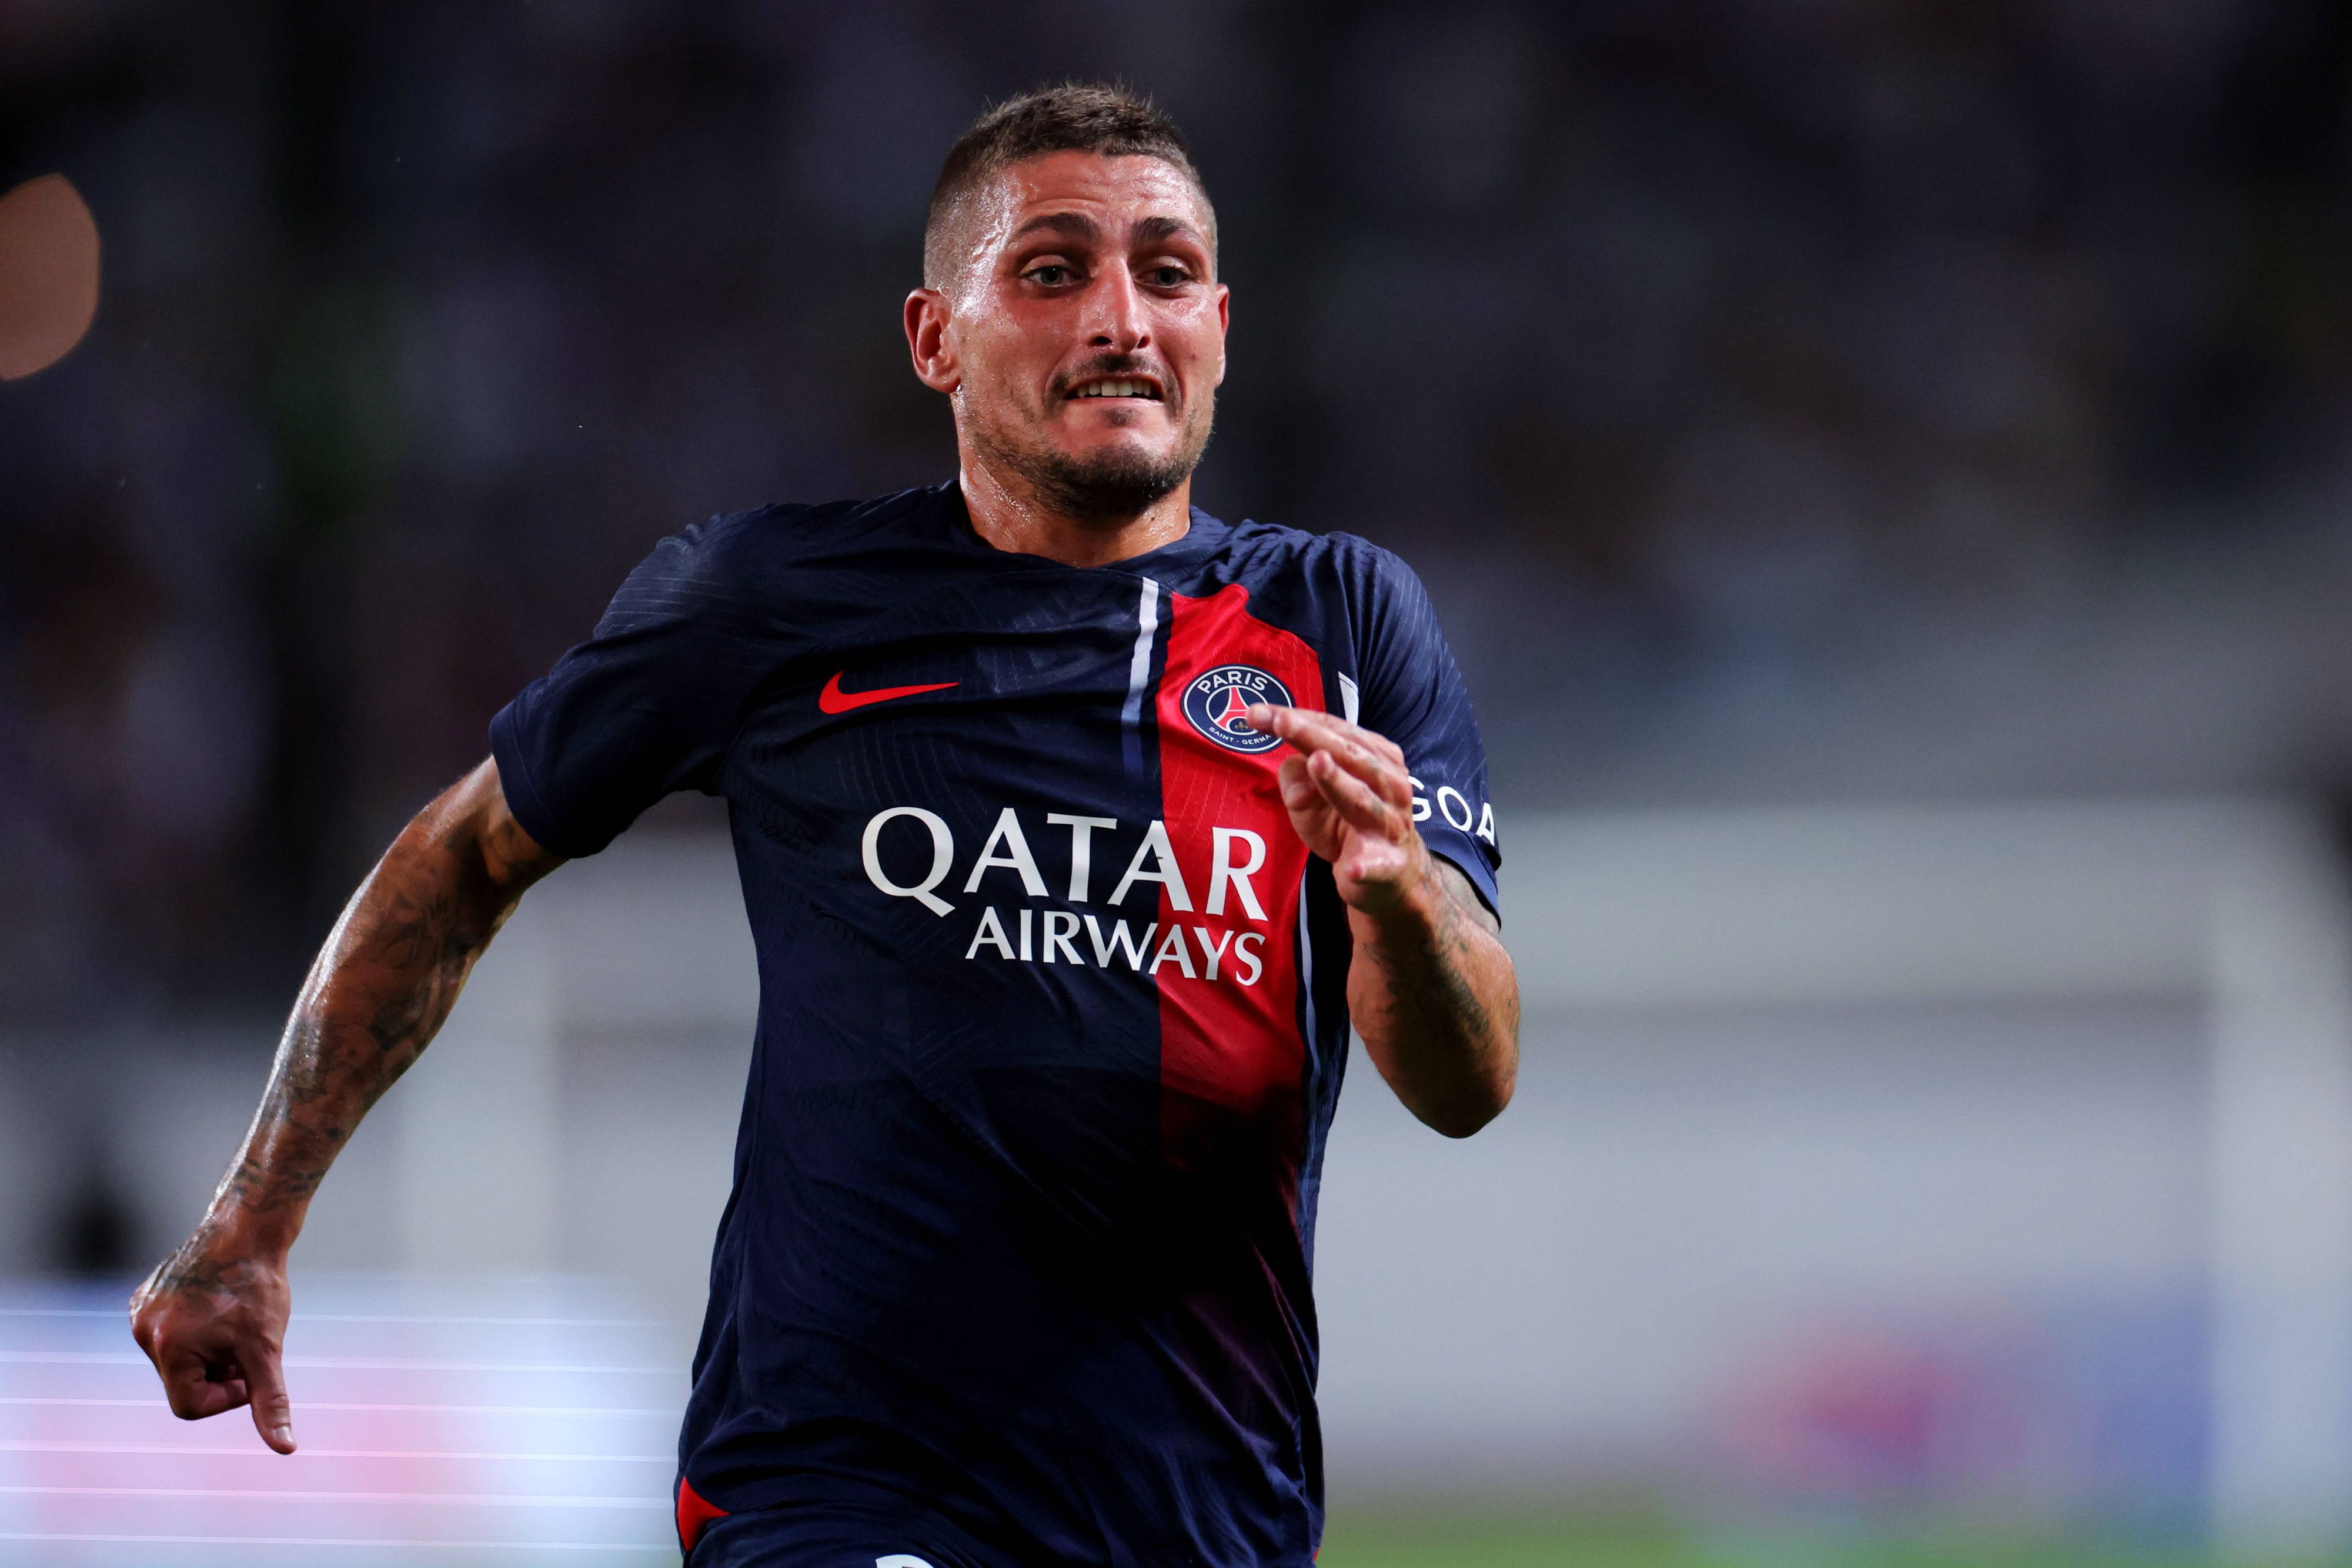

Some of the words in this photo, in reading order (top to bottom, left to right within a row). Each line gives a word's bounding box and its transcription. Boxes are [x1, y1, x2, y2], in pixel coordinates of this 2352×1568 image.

[1197, 671, 1268, 694] PARIS
[1208, 727, 1234, 743] SAINT
[1241, 733, 1272, 745] GERMA
[861, 806, 1268, 921] QATAR
[965, 905, 1265, 986] AIRWAYS
